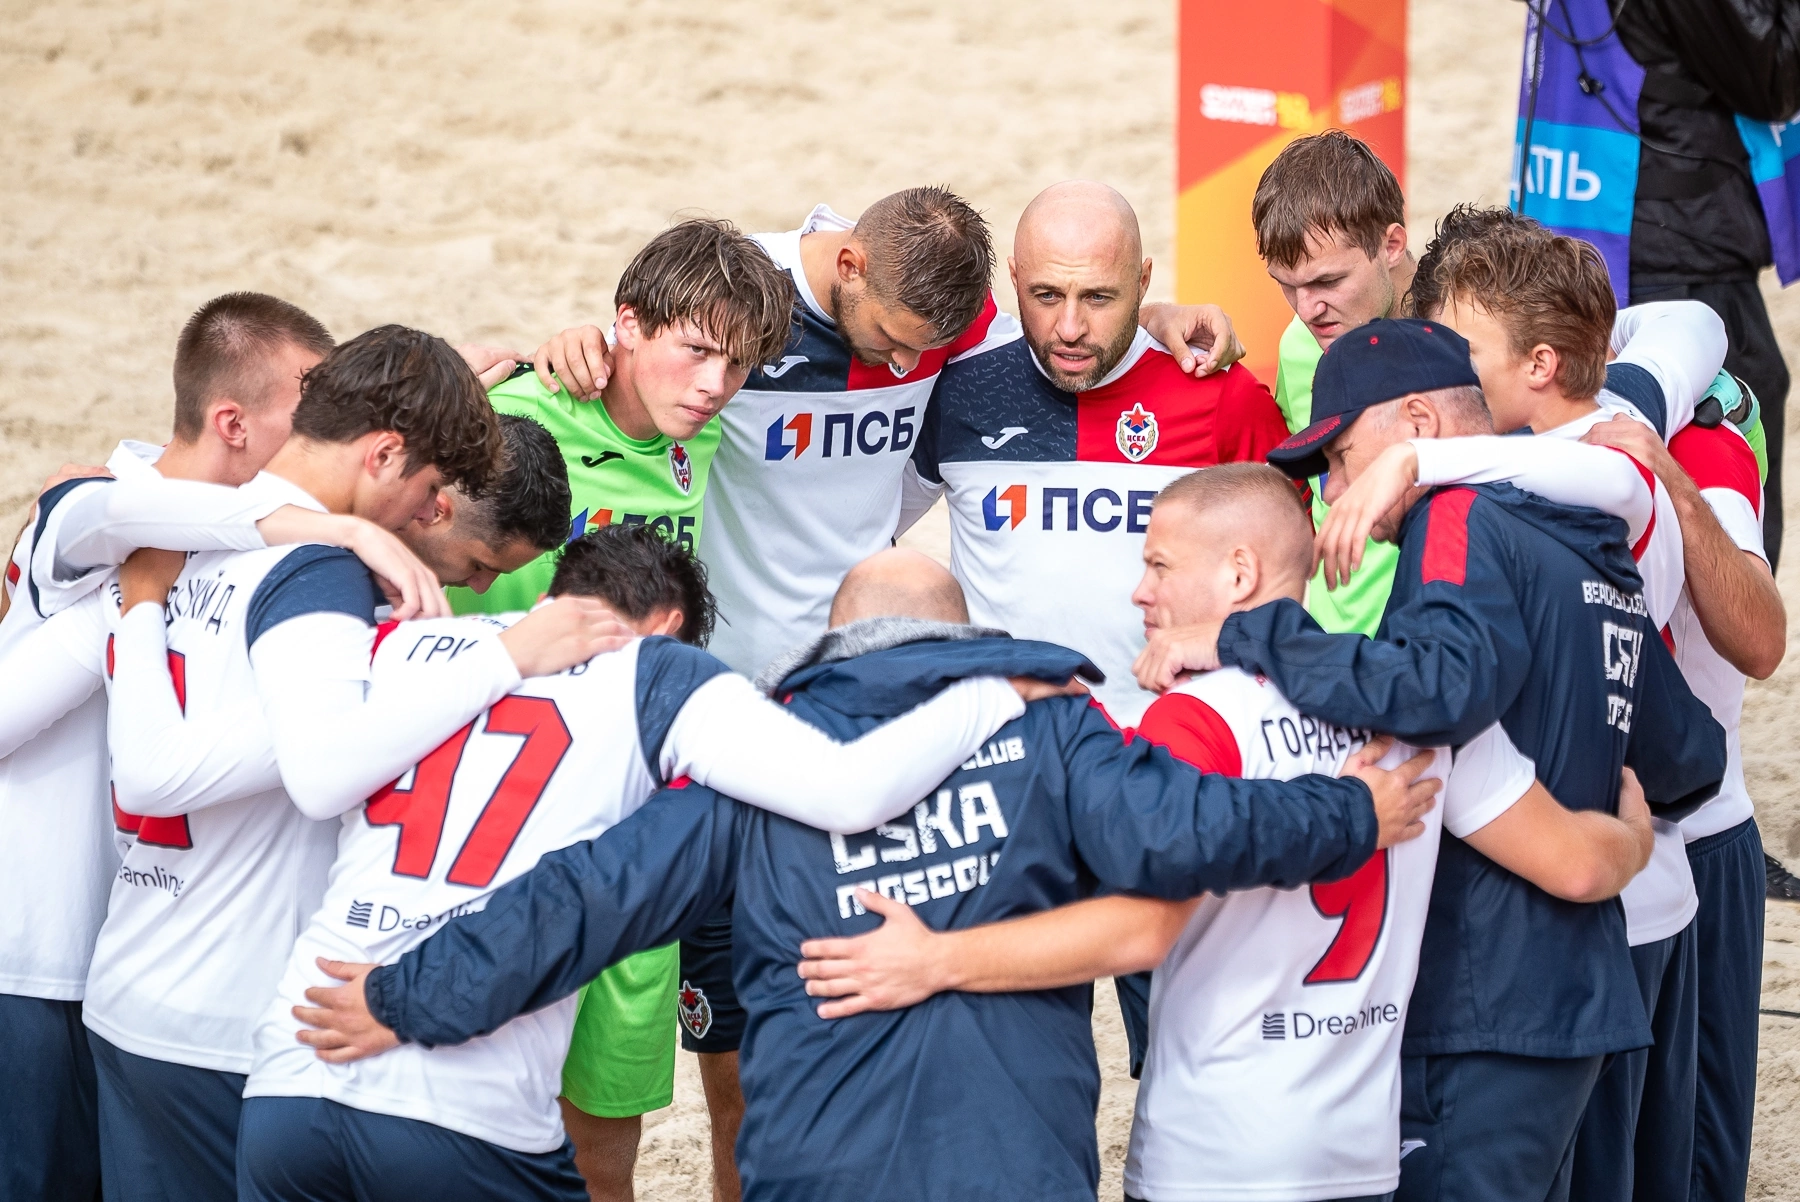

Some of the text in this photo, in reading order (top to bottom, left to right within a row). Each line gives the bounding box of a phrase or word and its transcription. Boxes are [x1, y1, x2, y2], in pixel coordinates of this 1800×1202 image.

[822, 406, 915, 457] ПСБ
[1042, 487, 1158, 533] ПСБ
[364, 694, 573, 888] 47
[829, 781, 1009, 875] CSKA
